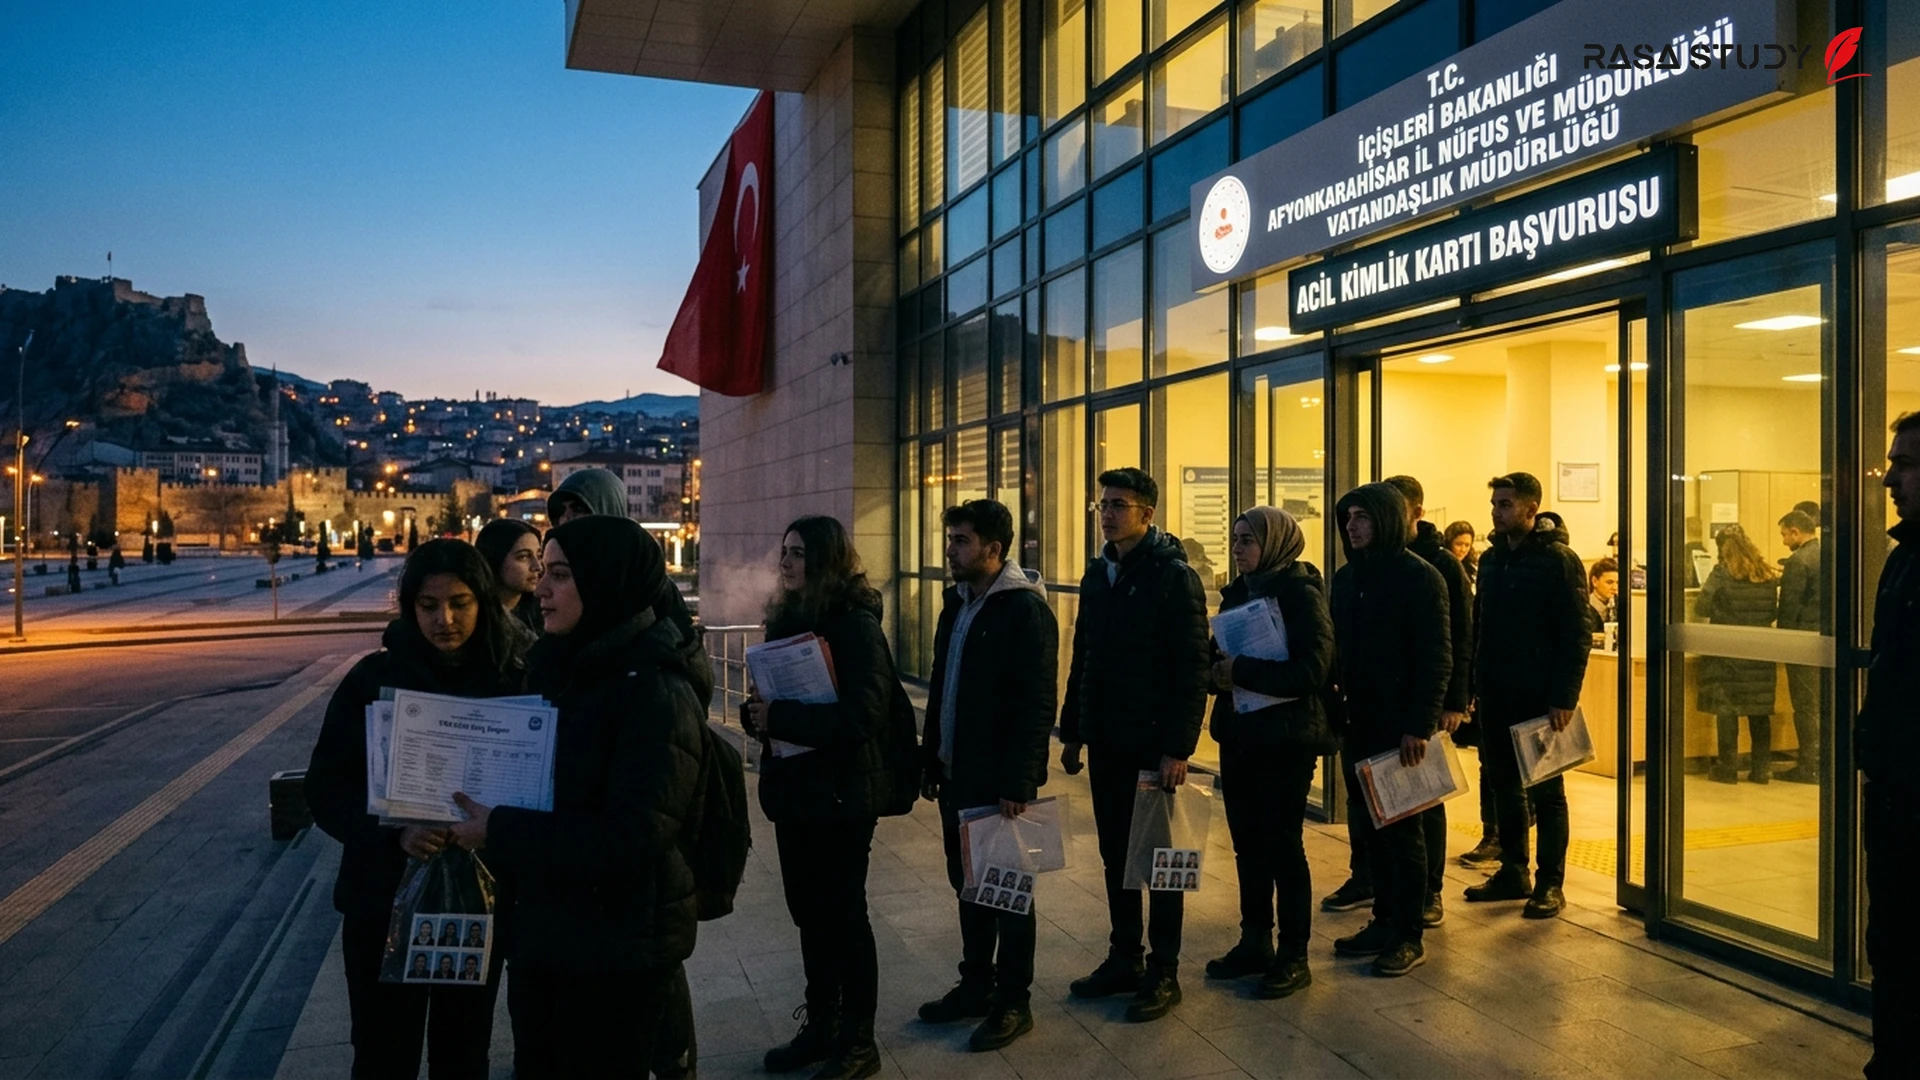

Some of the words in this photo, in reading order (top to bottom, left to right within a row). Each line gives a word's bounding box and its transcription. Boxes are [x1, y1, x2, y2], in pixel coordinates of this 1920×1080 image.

[1267, 155, 1409, 232] AFYONKARAHİSAR
[1415, 145, 1433, 175] İL
[1438, 114, 1509, 166] NÜFUS
[1515, 98, 1545, 134] VE
[1553, 16, 1733, 121] MÜDÜRLÜĞÜ
[1358, 103, 1434, 168] İÇİŞLERİ
[1440, 52, 1557, 129] BAKANLIĞI
[1427, 63, 1465, 98] T.C.
[1326, 171, 1454, 238] VATANDAŞLIK
[1460, 103, 1620, 192] MÜDÜRLÜĞÜ
[1296, 267, 1336, 314] ACİL
[1340, 250, 1410, 302] KİMLİK
[1415, 231, 1481, 282] KARTI
[1489, 176, 1660, 261] BAŞVURUSU
